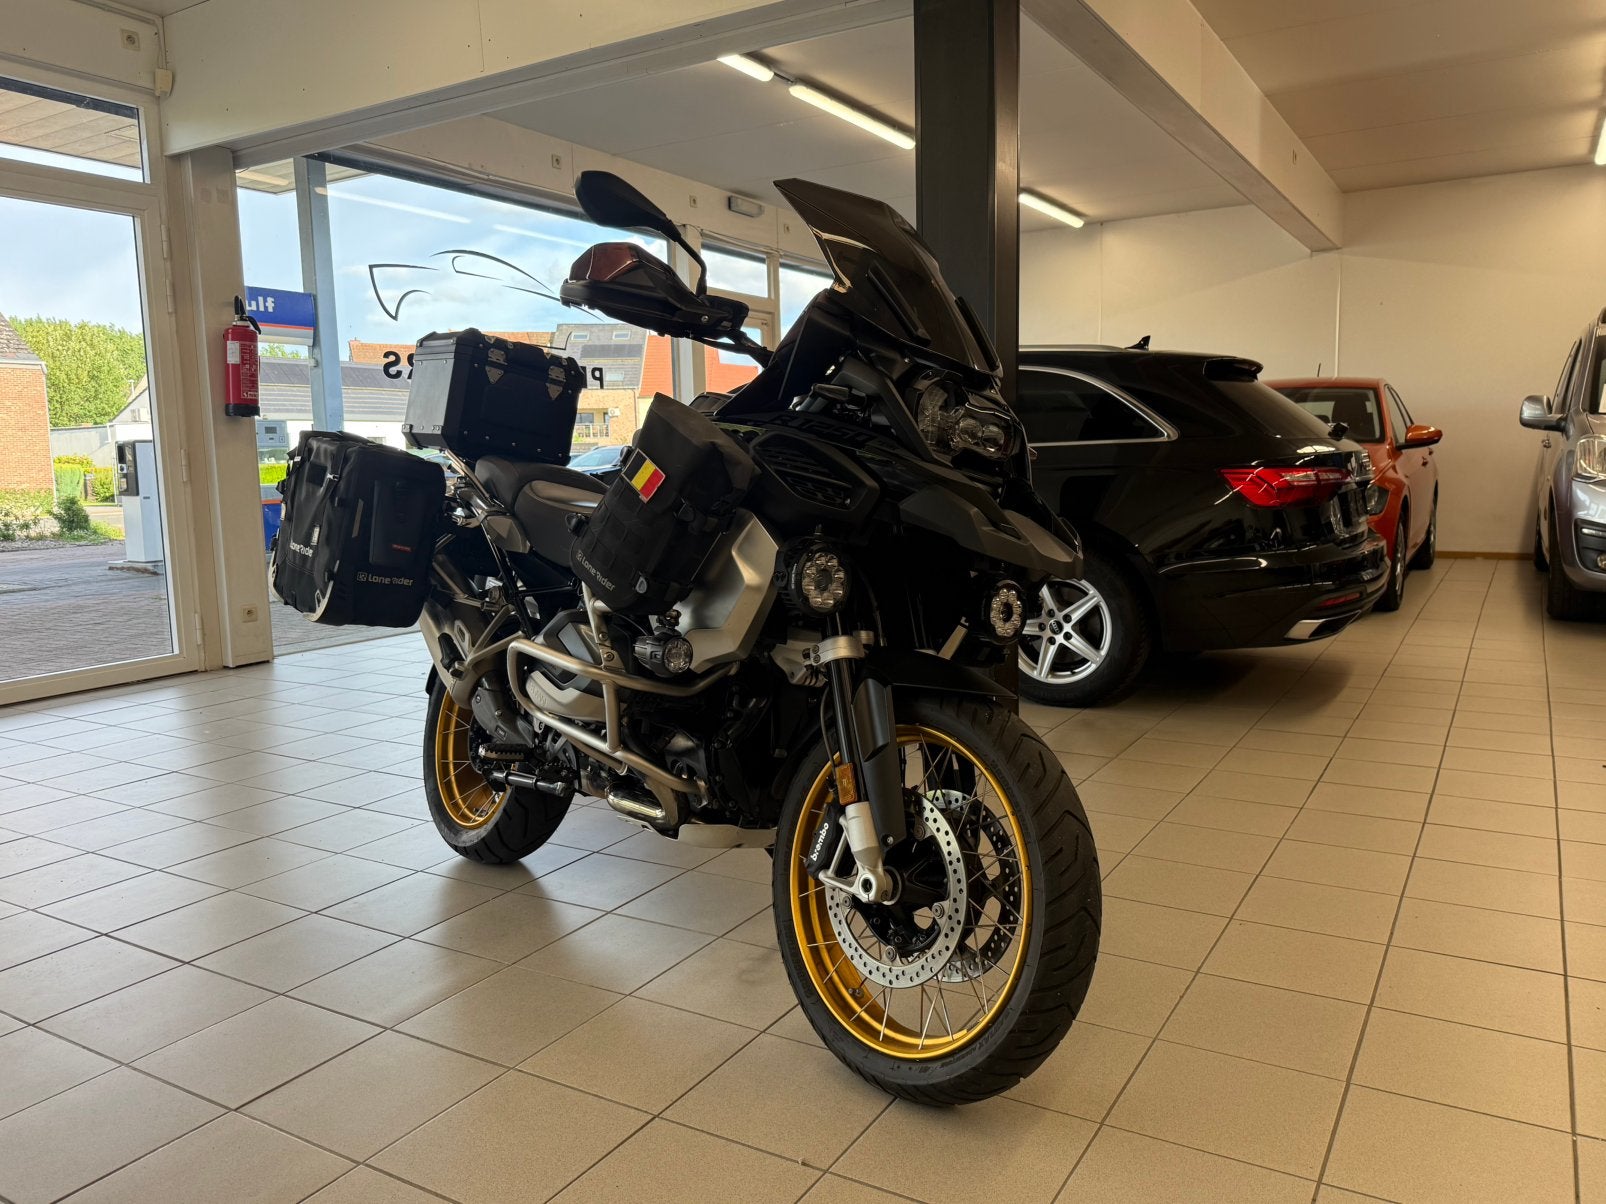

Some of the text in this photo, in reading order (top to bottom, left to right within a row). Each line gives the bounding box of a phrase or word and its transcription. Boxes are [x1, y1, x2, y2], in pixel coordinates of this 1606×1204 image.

[246, 296, 275, 312] ulf
[368, 573, 391, 584] Lone
[581, 556, 597, 576] Lone
[596, 572, 616, 591] Rider
[810, 822, 829, 861] brembo
